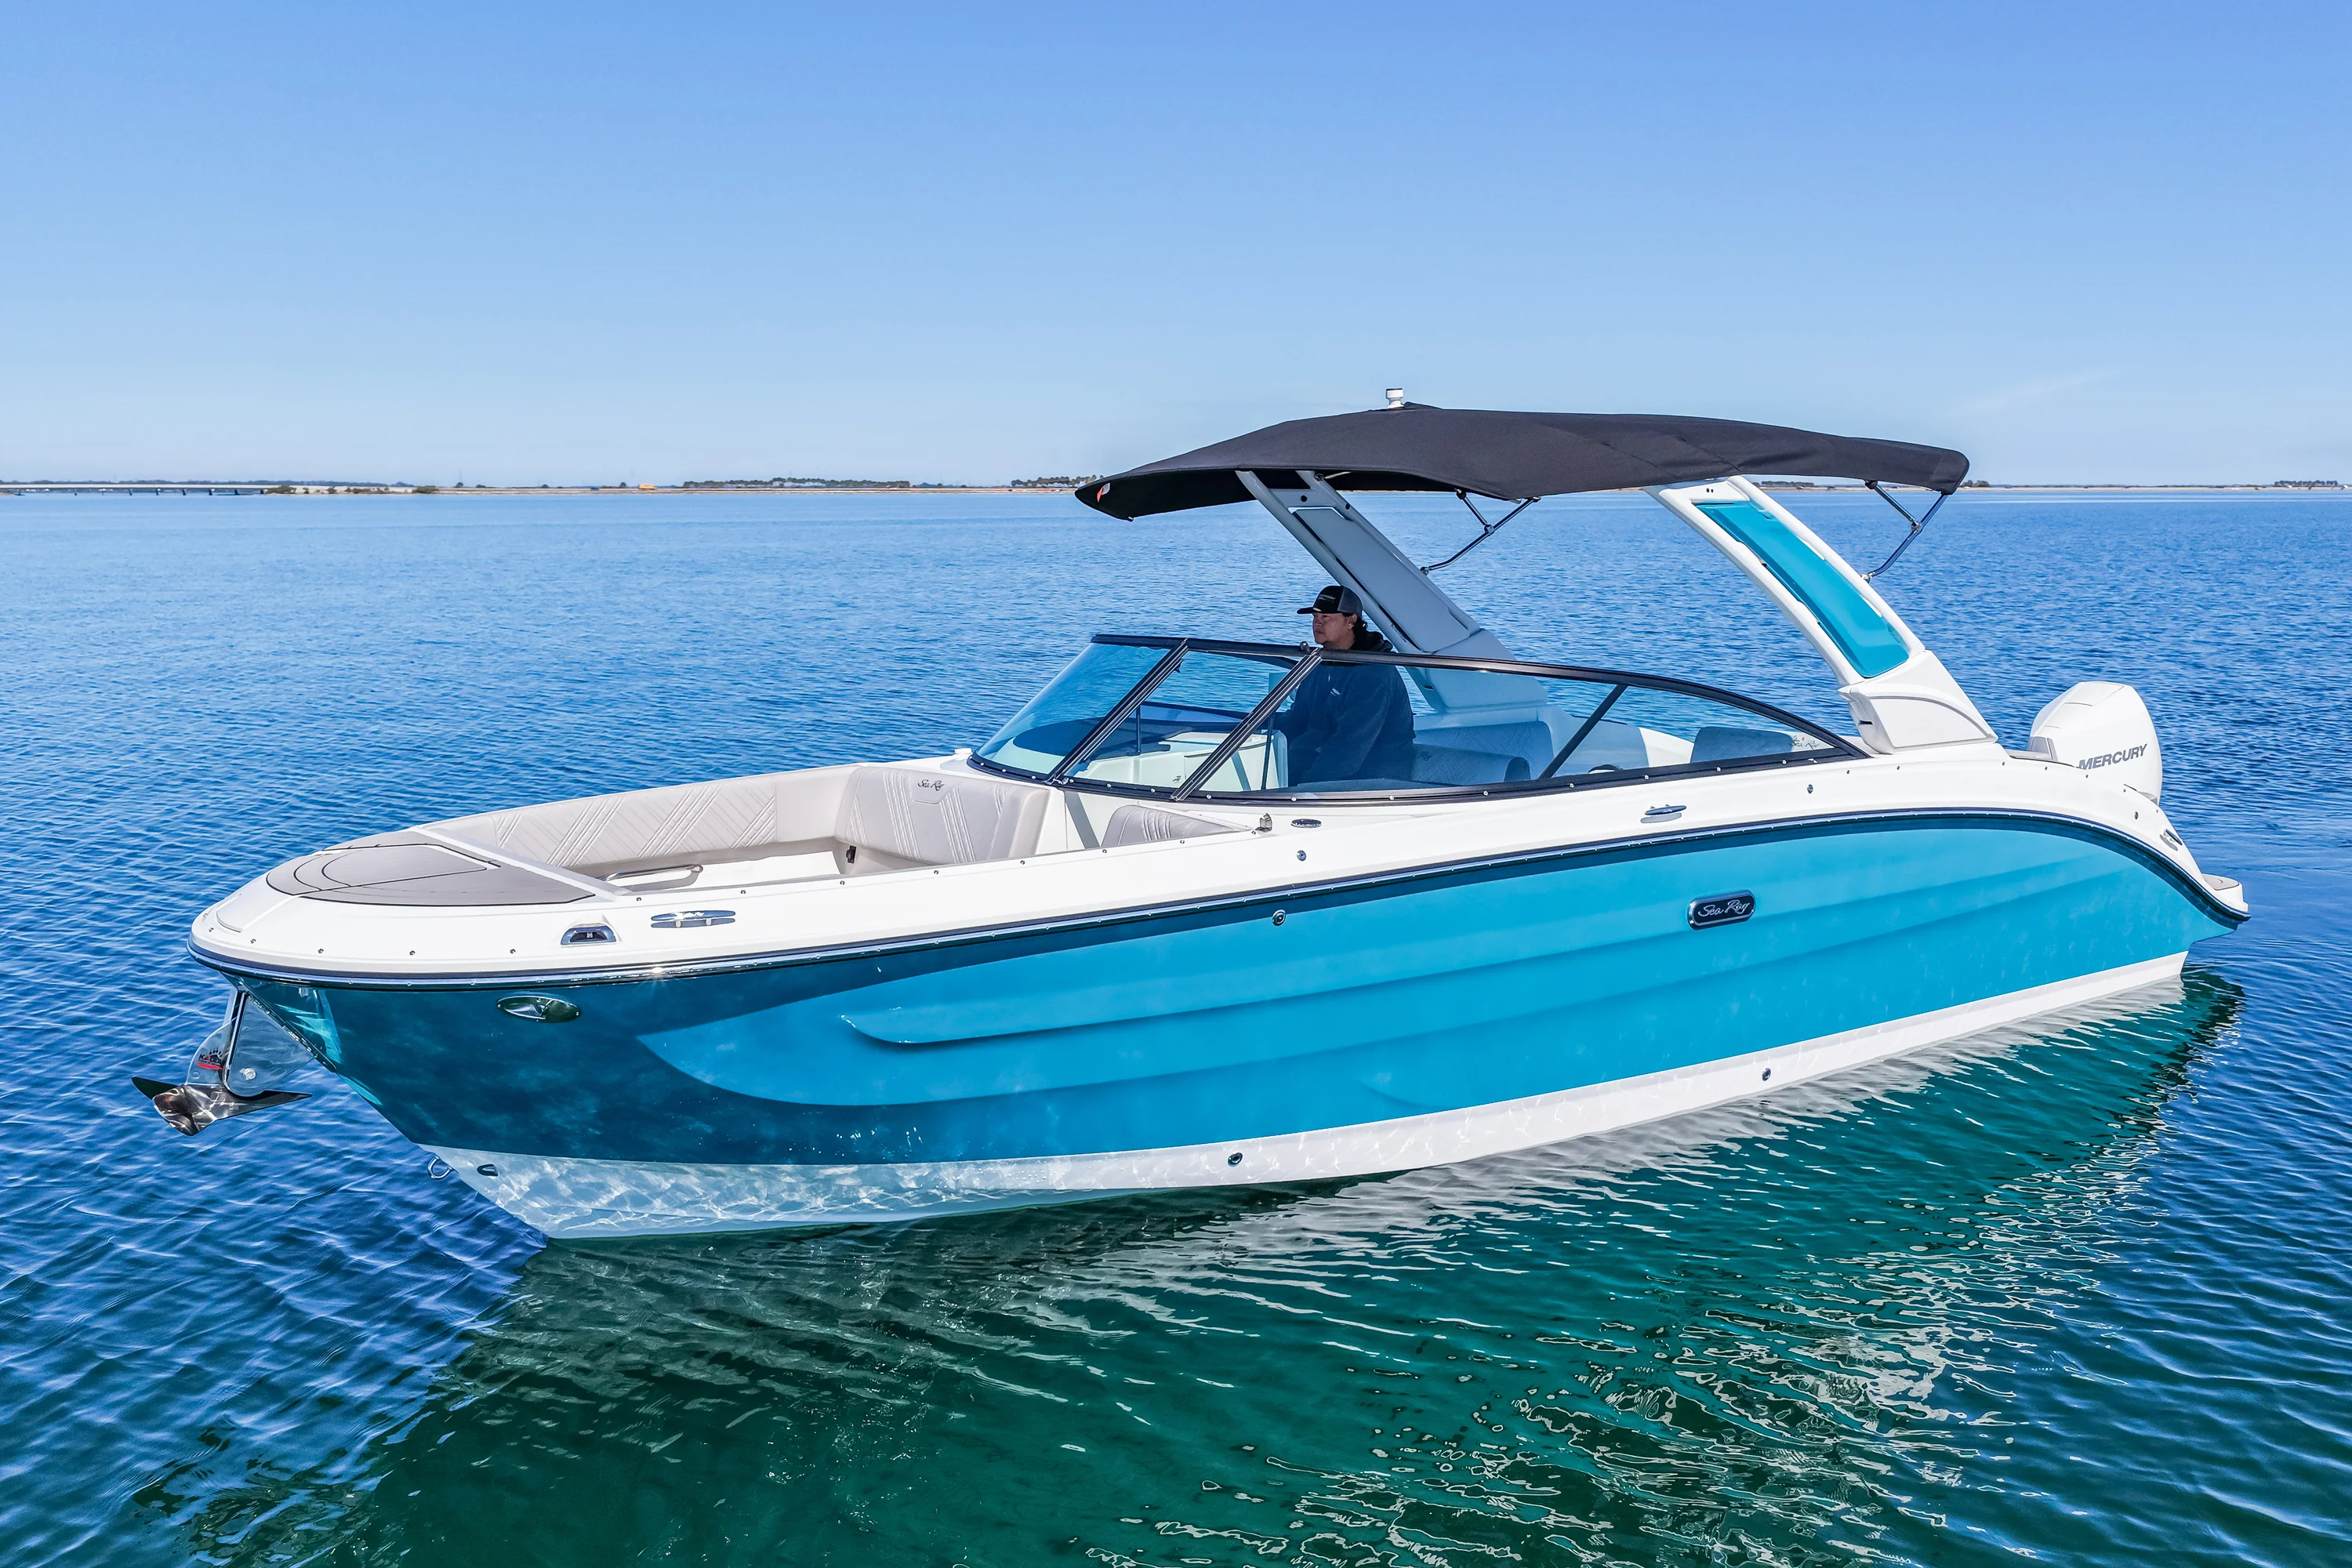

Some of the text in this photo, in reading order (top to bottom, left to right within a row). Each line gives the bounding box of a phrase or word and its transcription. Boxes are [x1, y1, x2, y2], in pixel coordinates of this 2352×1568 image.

[2078, 743, 2147, 770] MERCURY
[917, 779, 930, 789] Sea
[1697, 899, 1751, 917] Sea Ray
